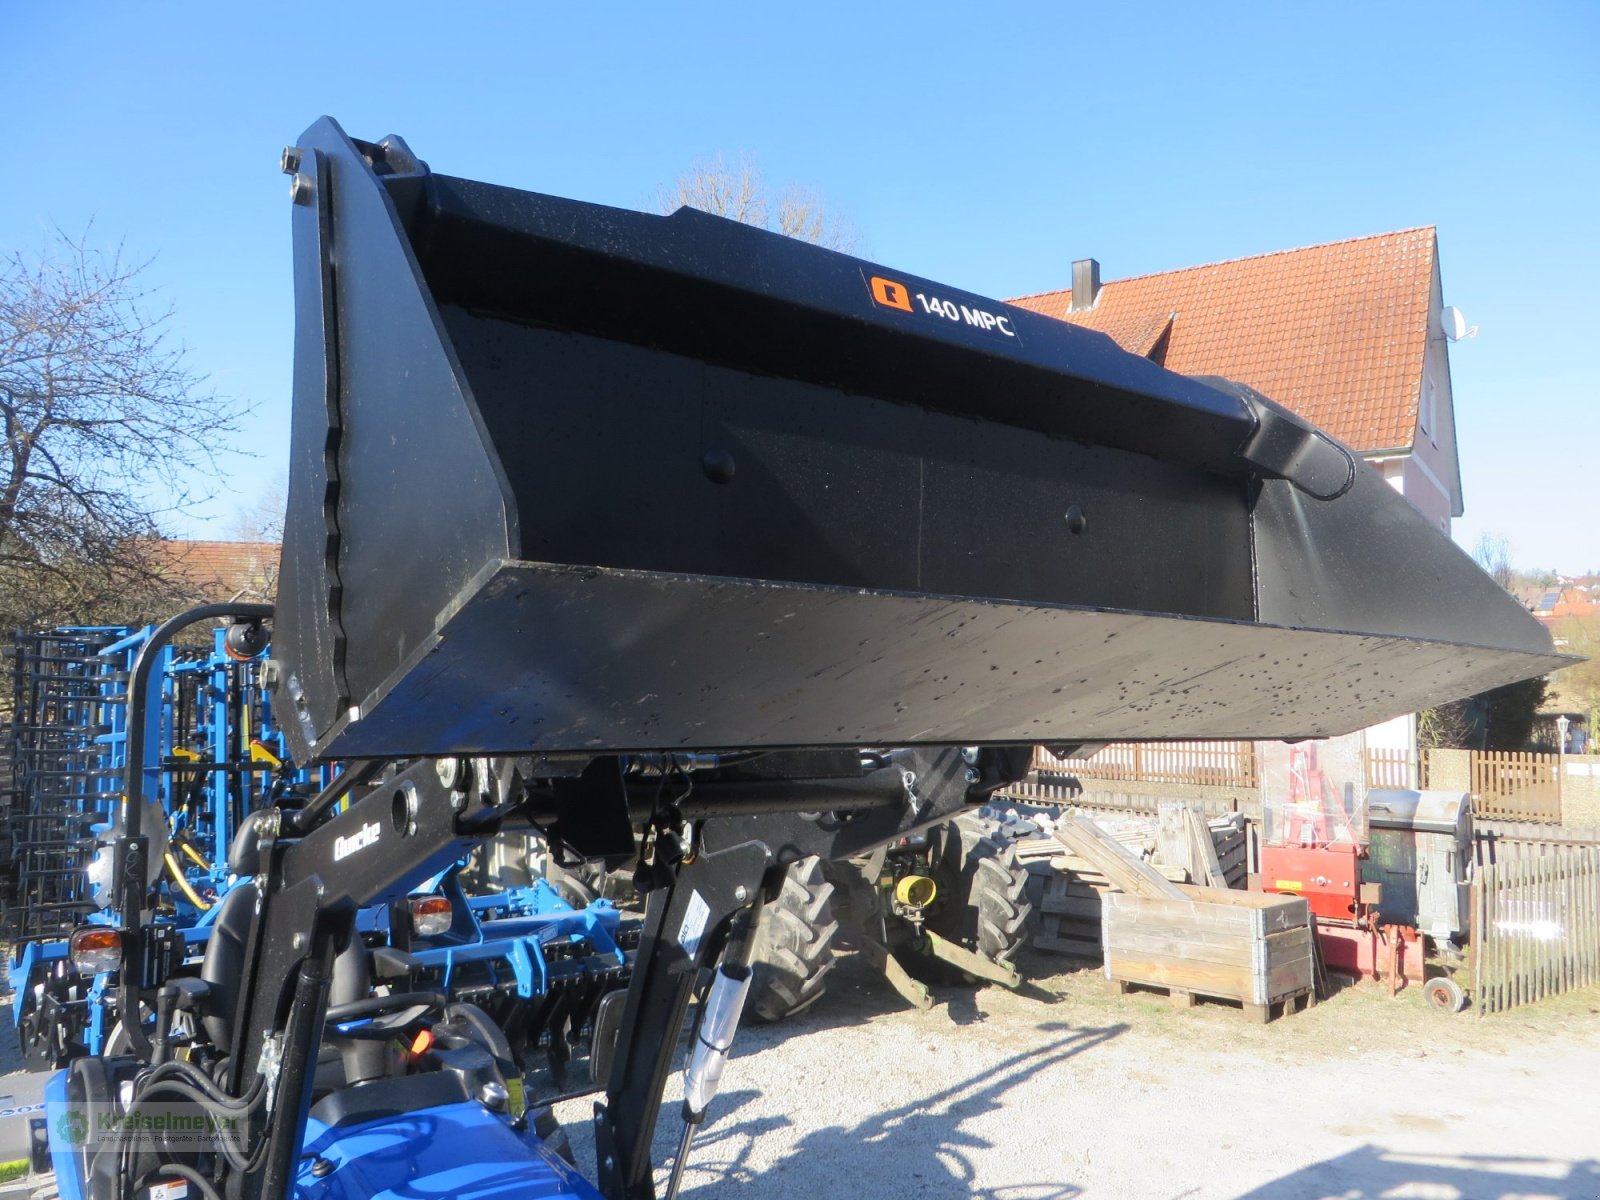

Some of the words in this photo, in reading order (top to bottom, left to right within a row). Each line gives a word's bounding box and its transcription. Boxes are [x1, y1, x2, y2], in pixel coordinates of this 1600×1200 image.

[916, 294, 960, 322] 140
[960, 305, 1015, 337] MPC
[334, 822, 381, 861] Quicke
